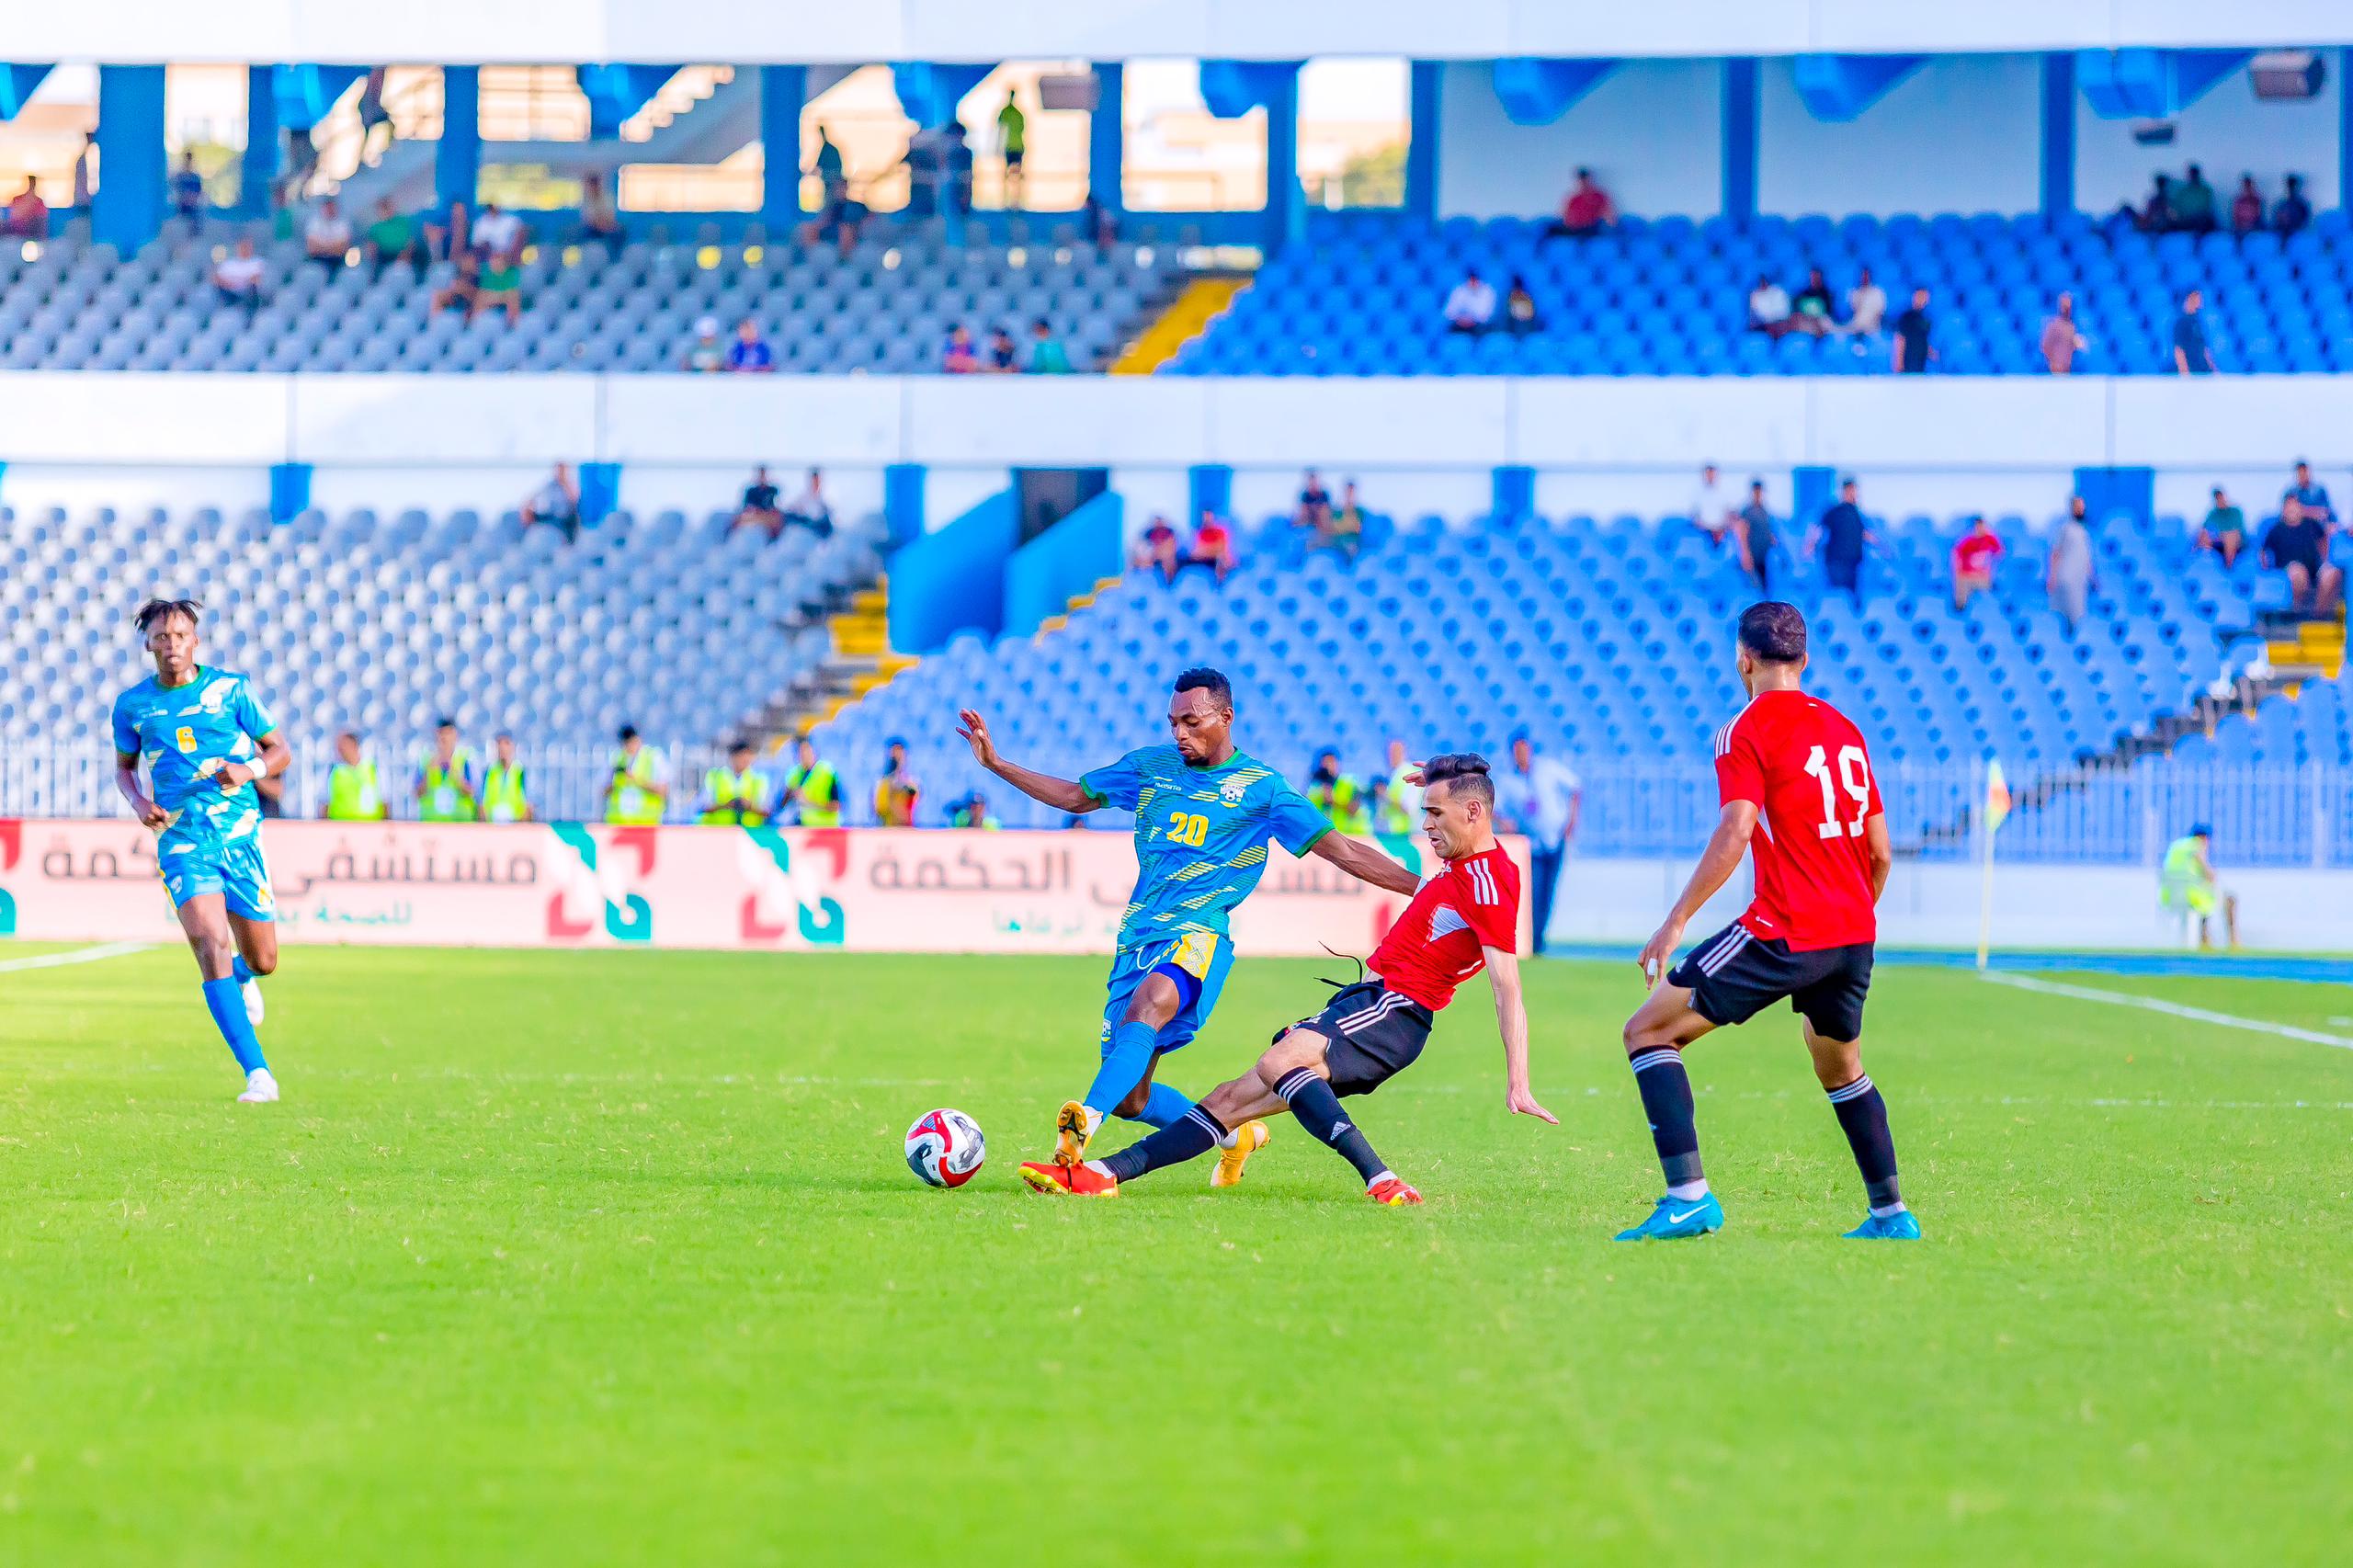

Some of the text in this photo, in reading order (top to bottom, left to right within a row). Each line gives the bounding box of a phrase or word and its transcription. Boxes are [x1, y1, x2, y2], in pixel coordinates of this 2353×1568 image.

[176, 725, 198, 754] 6
[1803, 744, 1871, 840] 19
[1166, 811, 1210, 847] 20
[870, 846, 1071, 891] الحكمة
